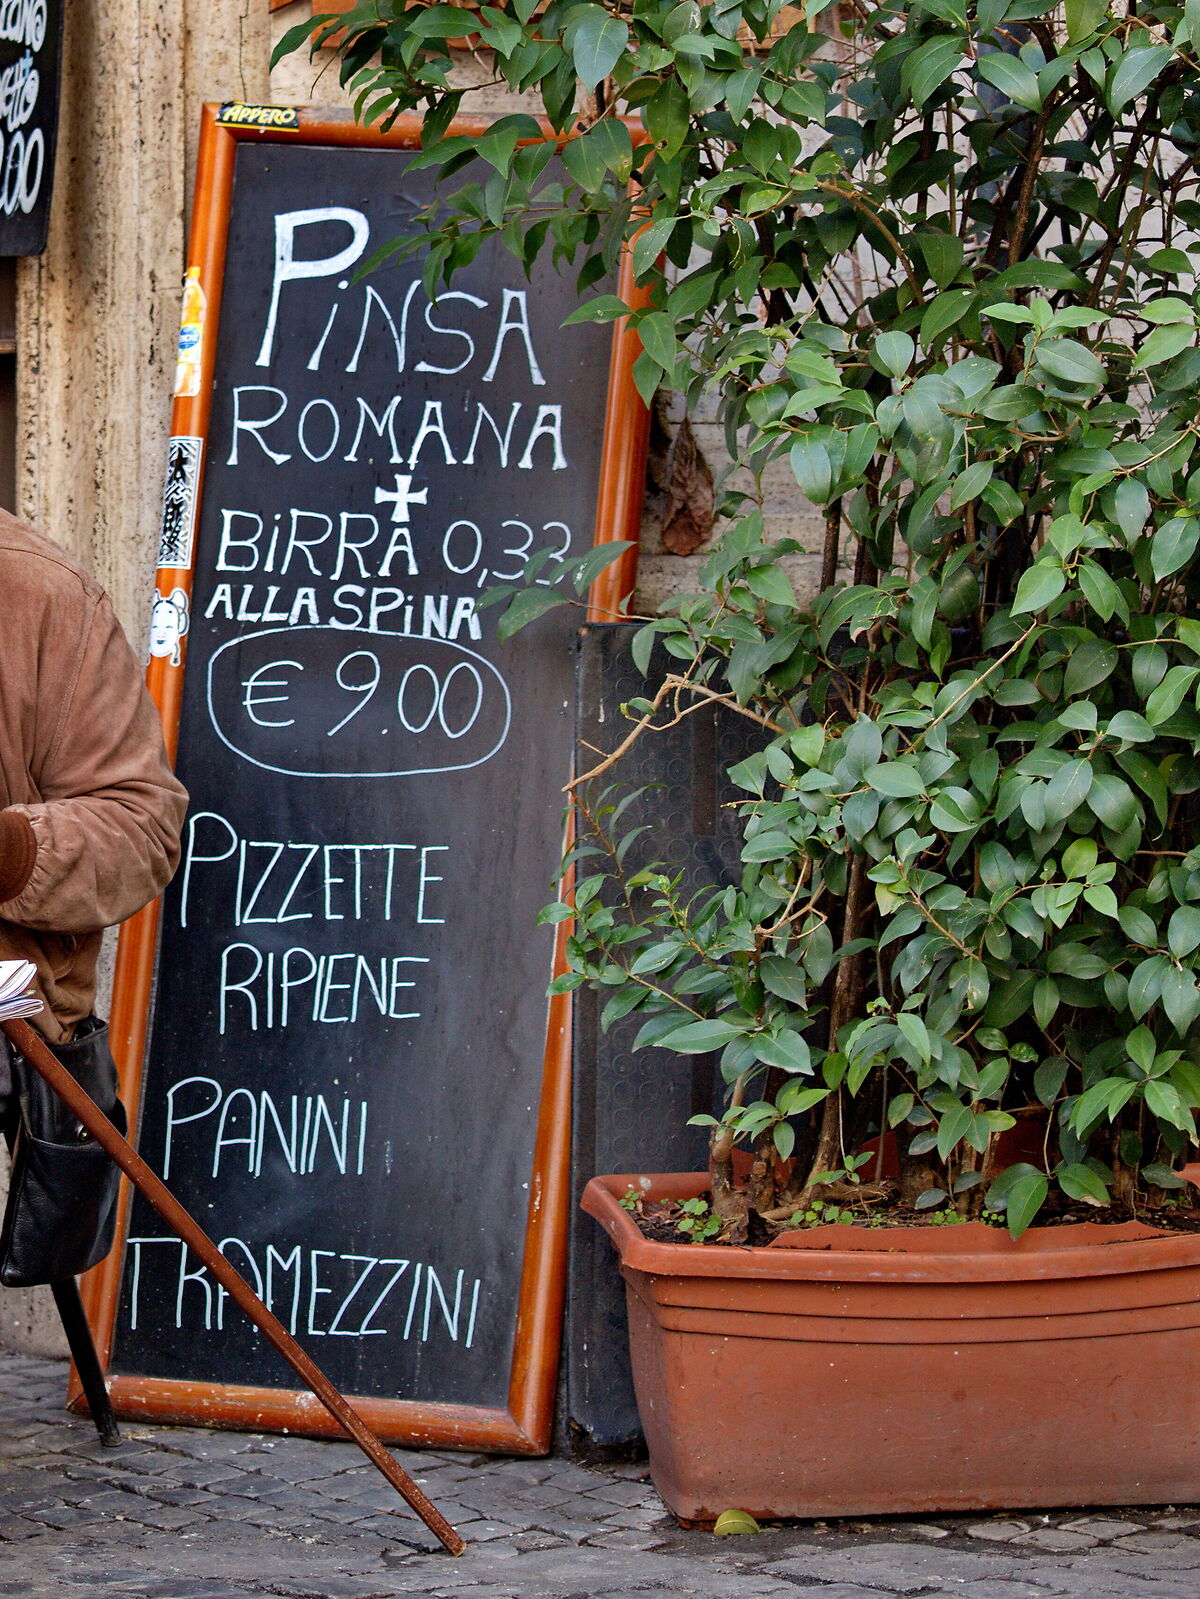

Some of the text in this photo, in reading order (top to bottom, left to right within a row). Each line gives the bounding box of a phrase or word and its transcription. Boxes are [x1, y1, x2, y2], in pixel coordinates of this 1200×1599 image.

[227, 385, 568, 470] ROMANA
[442, 520, 573, 589] 0,33
[204, 583, 320, 625] ALLA
[181, 812, 450, 928] PIZZETTE
[219, 943, 431, 1035] RIPIENE
[163, 1076, 367, 1181] PANINI
[127, 1237, 481, 1348] TRAMEZZINI
